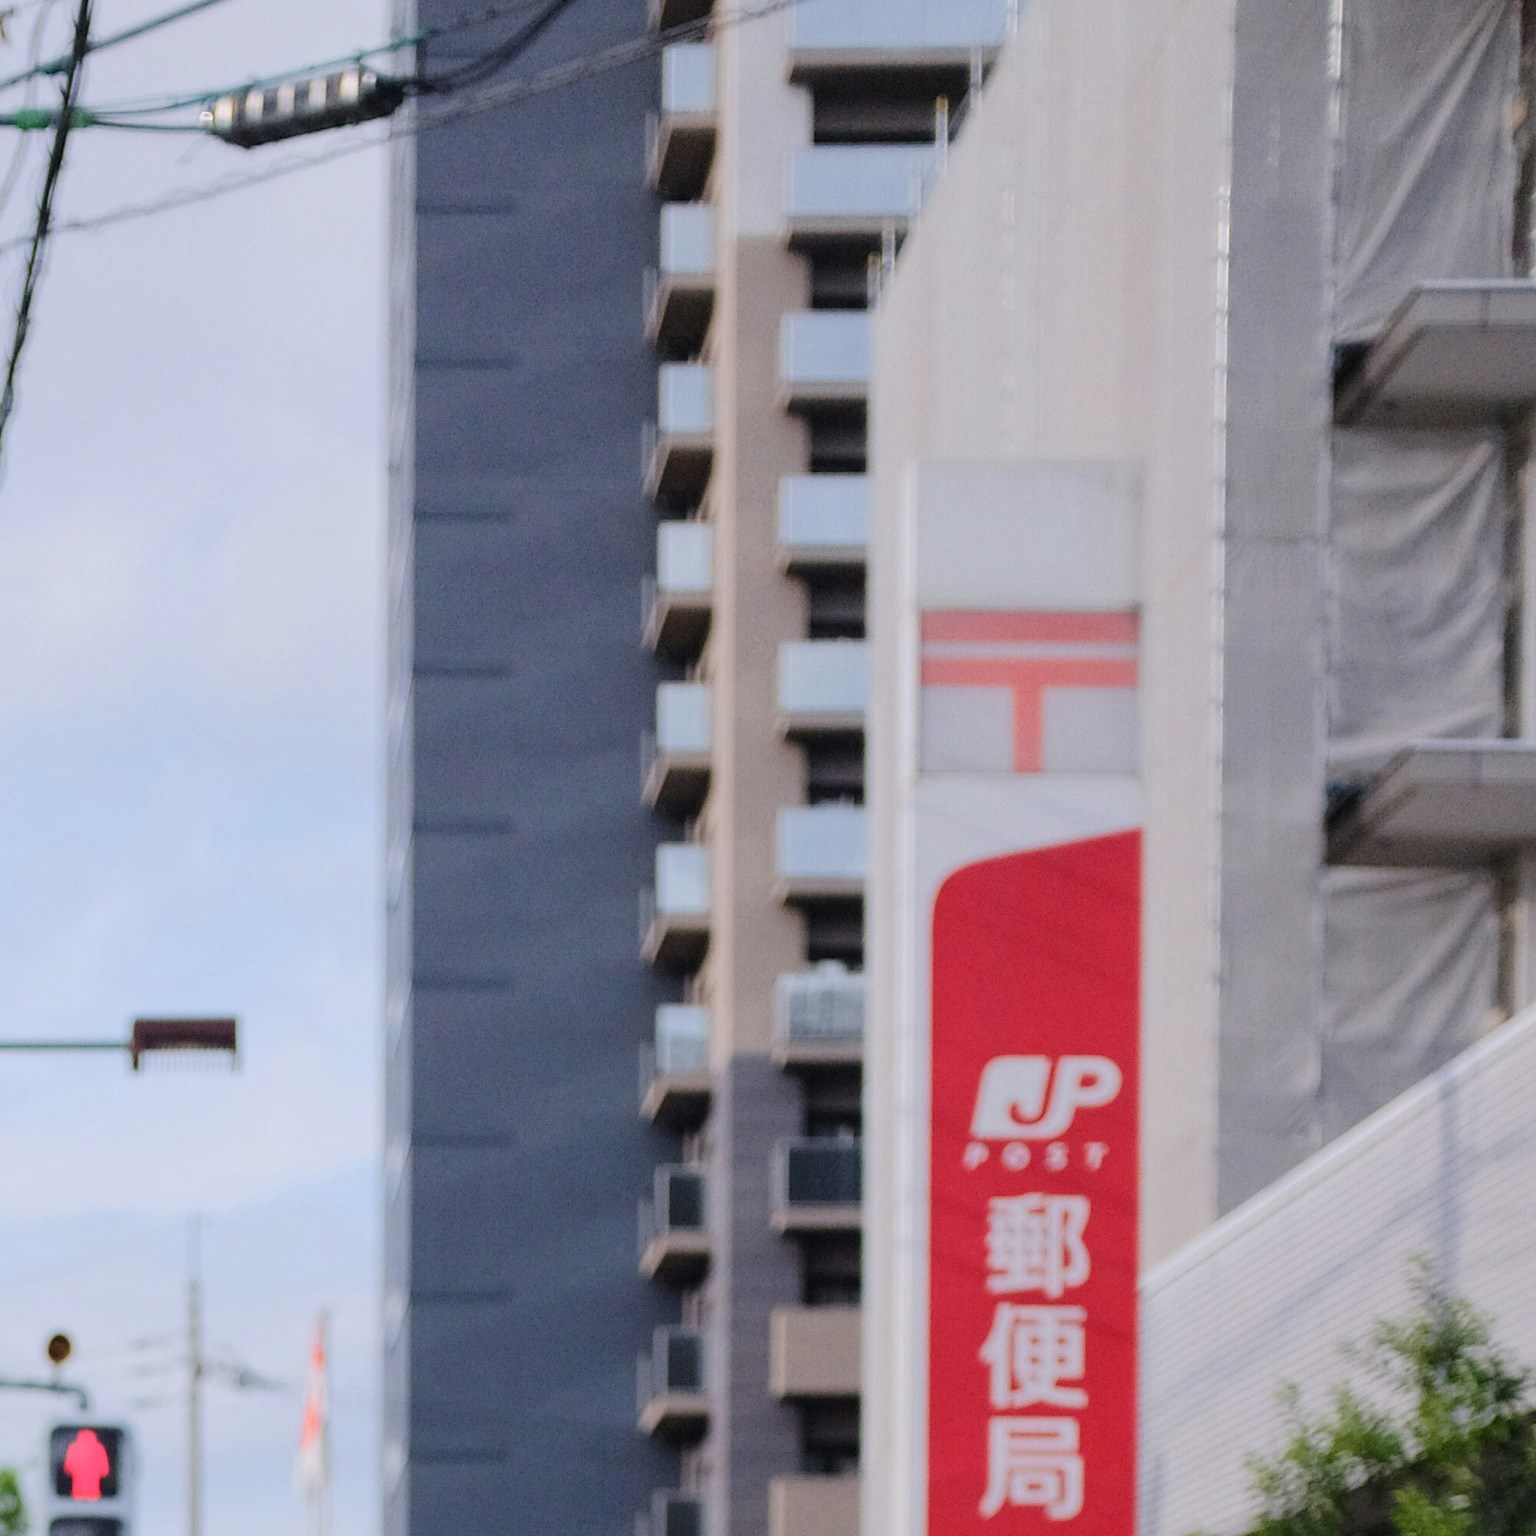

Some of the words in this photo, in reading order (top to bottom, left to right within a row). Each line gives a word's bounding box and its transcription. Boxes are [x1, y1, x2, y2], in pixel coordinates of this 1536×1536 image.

[965, 1141, 1110, 1171] POST
[978, 1192, 1091, 1521] 郵便局
